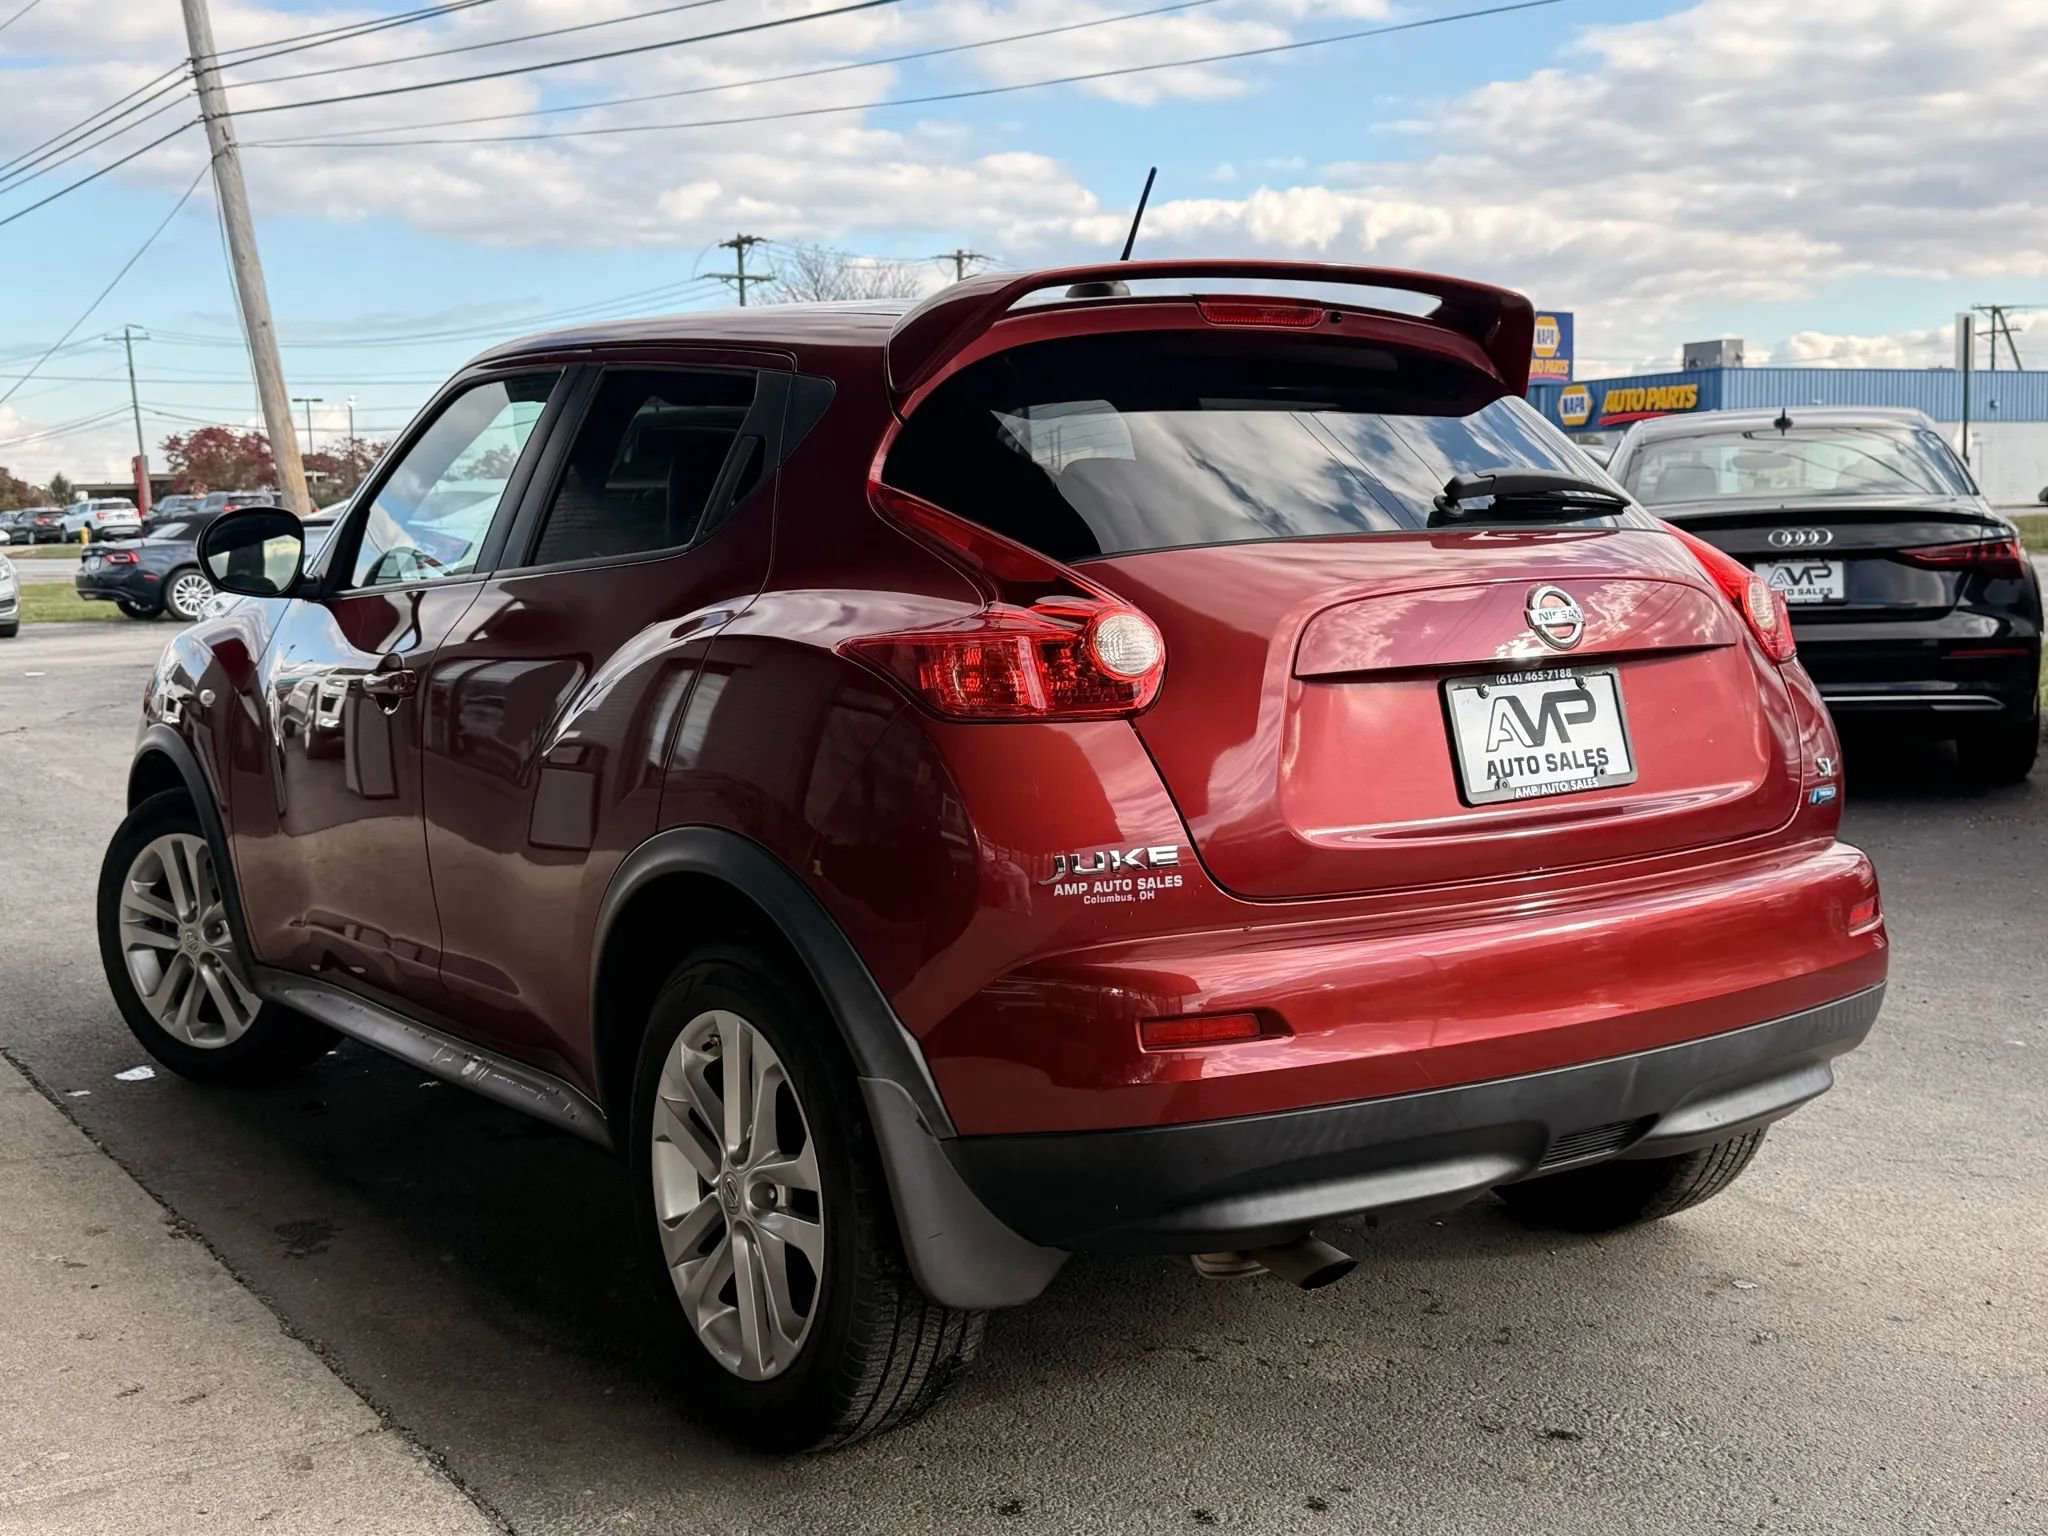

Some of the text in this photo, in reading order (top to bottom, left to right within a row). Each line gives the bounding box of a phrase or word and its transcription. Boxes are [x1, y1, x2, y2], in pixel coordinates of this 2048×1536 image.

[1537, 328, 1555, 345] NAPA
[1544, 359, 1569, 374] PARTS
[1562, 384, 1698, 415] NAPA AUTO PARTS
[1797, 587, 1833, 597] SALES
[1538, 609, 1582, 622] NISSAN
[1496, 668, 1572, 685] (614) 465-7188
[1486, 747, 1609, 780] AUTO SALES
[1515, 777, 1599, 799] AMP AUTO SALES
[1038, 845, 1180, 886] JUKE
[1054, 875, 1183, 896] AMP AUTO SALES
[1083, 890, 1155, 905] Columbus, OH
